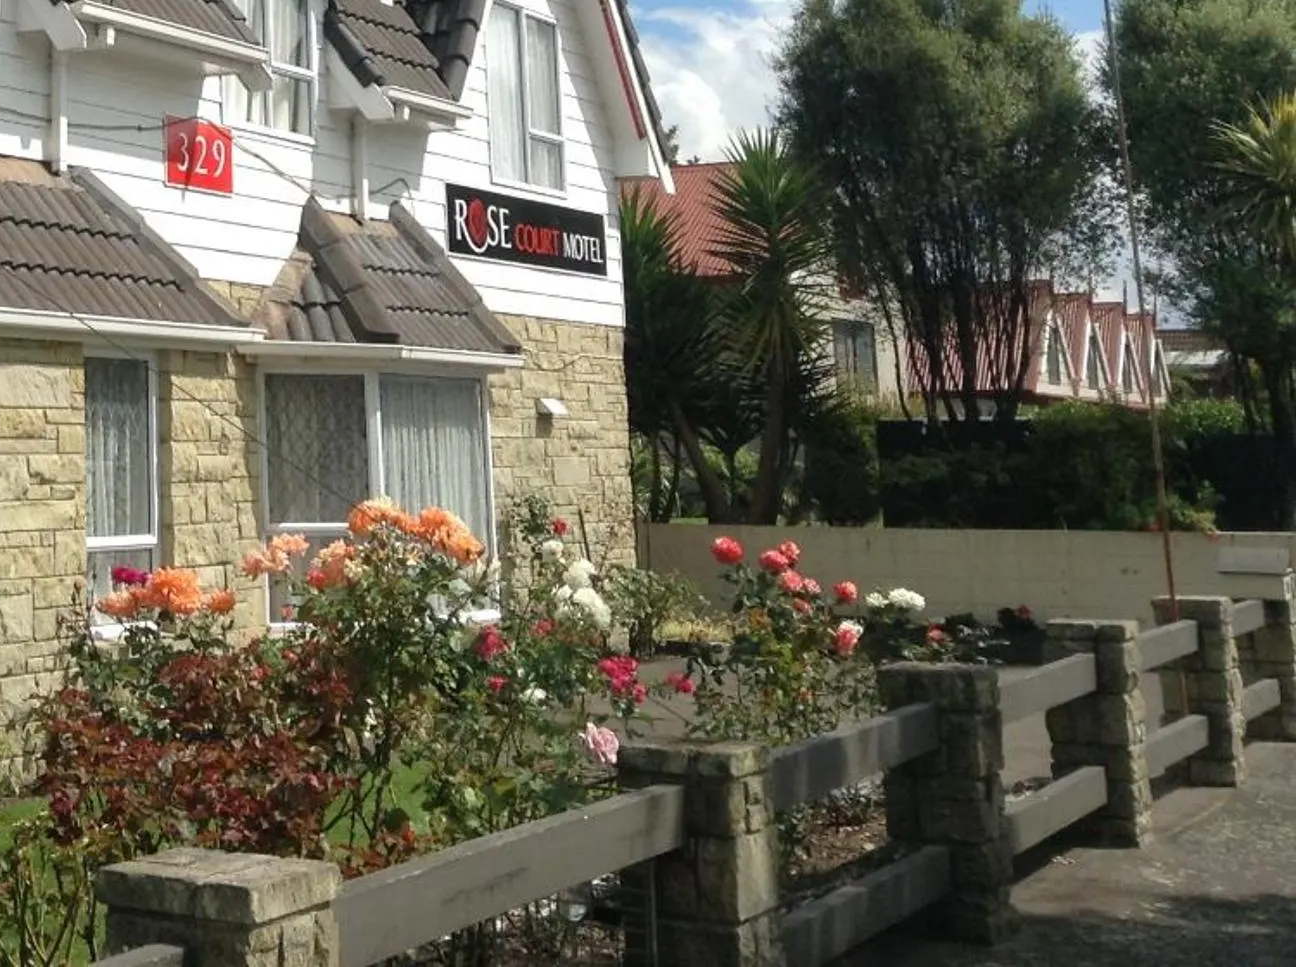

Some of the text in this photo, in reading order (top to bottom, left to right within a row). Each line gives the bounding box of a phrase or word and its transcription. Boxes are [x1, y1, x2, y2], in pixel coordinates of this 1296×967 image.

[177, 132, 226, 176] 329
[454, 195, 603, 263] ROSE COURT MOTEL
